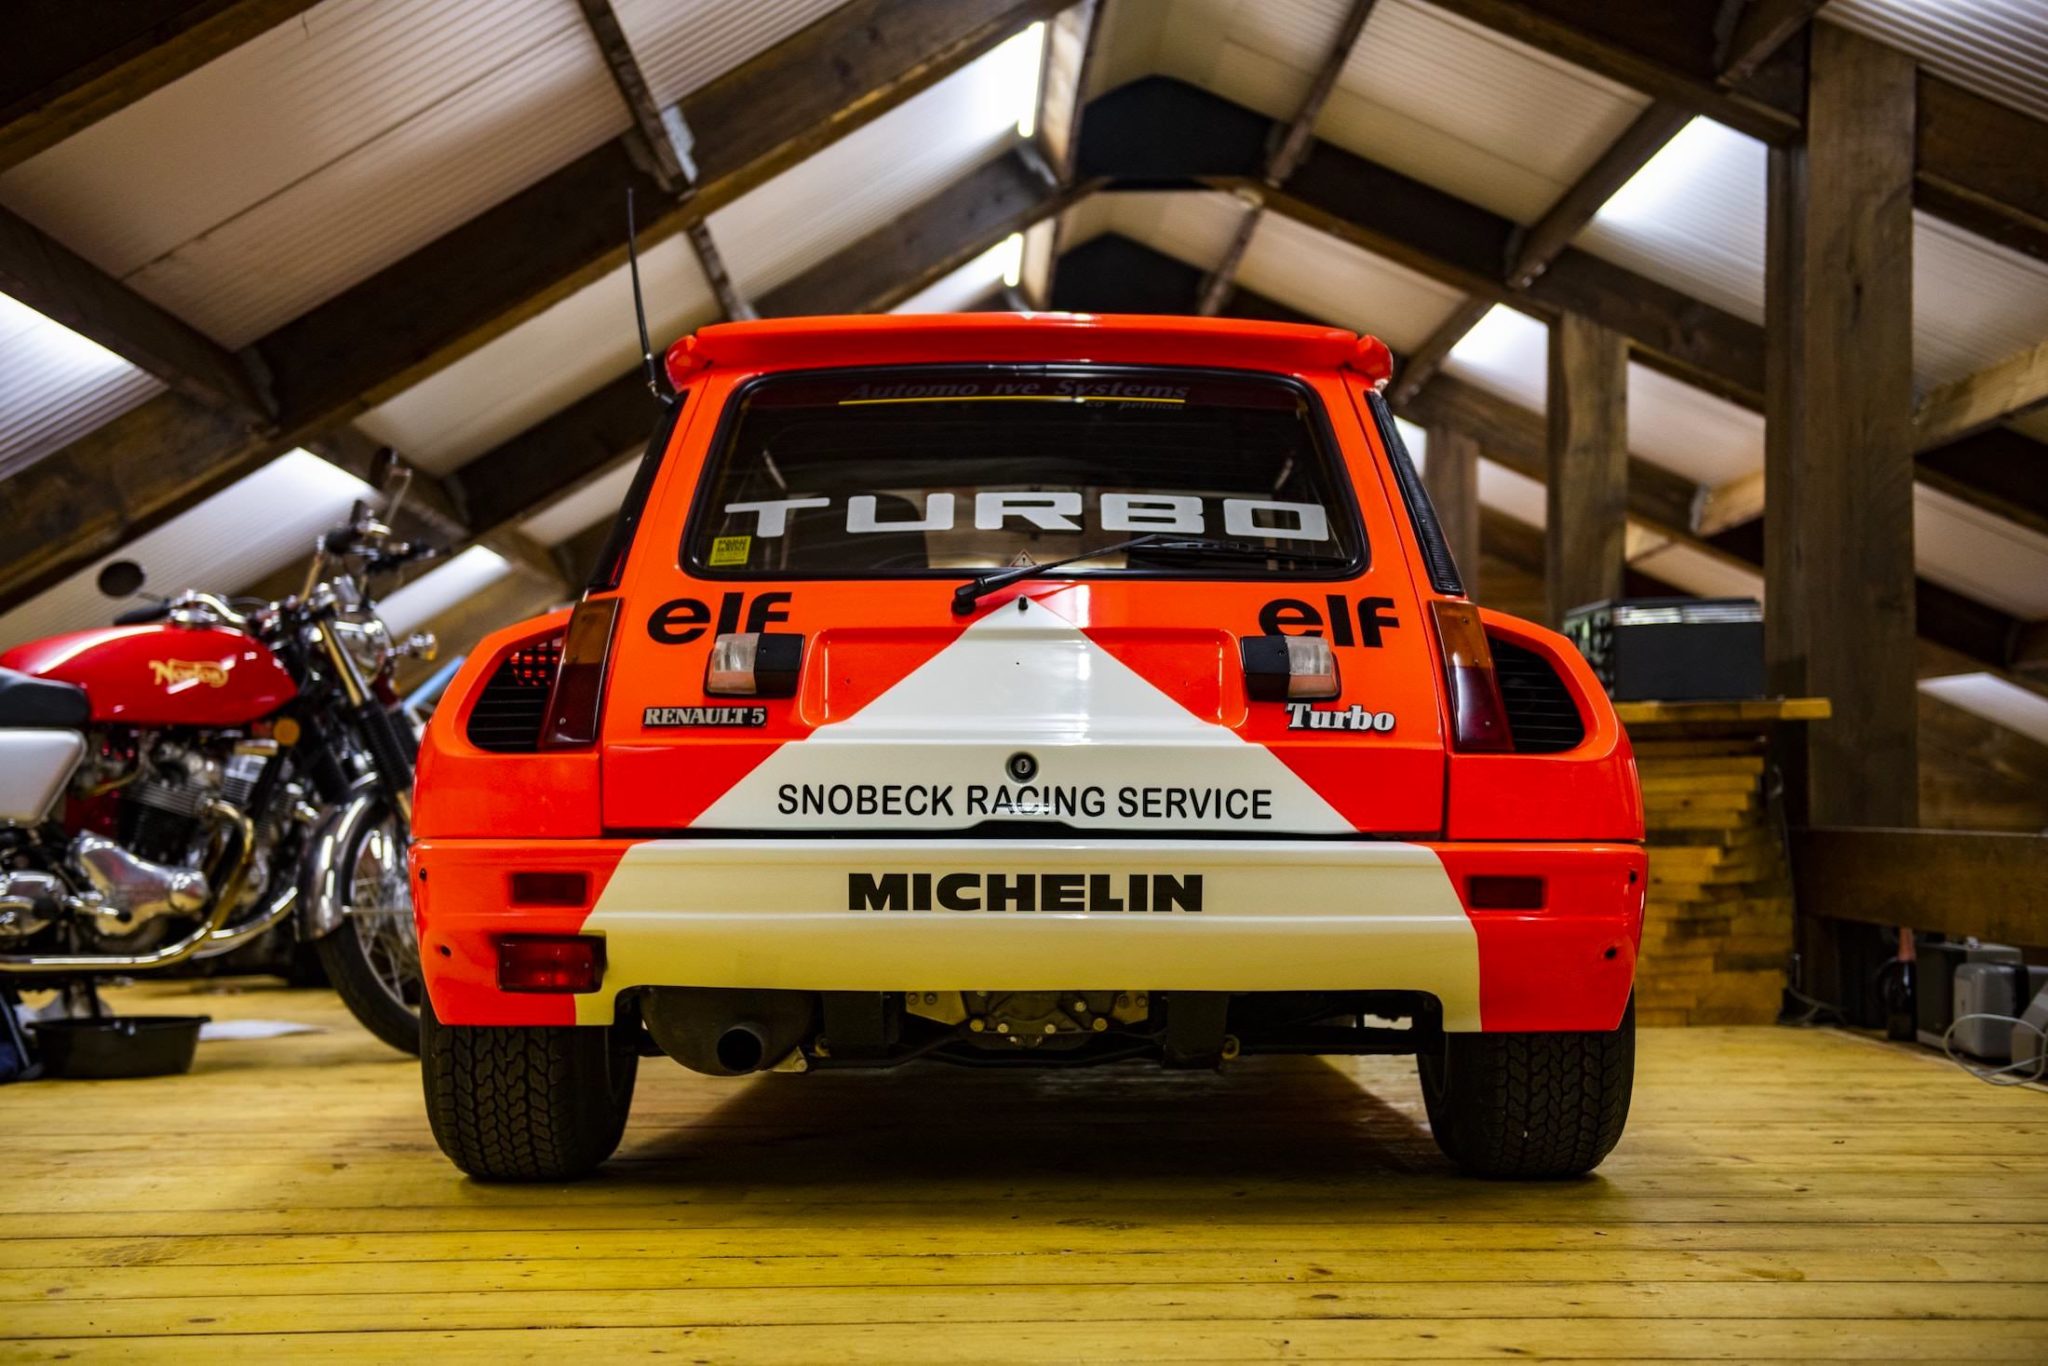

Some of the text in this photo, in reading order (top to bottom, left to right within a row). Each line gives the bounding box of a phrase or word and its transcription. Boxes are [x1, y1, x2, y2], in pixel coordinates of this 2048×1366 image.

[1054, 380, 1191, 398] Systems
[724, 492, 1329, 540] TURBO
[647, 591, 793, 645] elf
[1258, 594, 1400, 648] elf
[644, 708, 766, 725] RENAULT 5
[1287, 702, 1396, 732] Turbo
[777, 784, 1273, 820] SNOBECK RACING SERVICE
[848, 872, 1204, 912] MICHELIN
